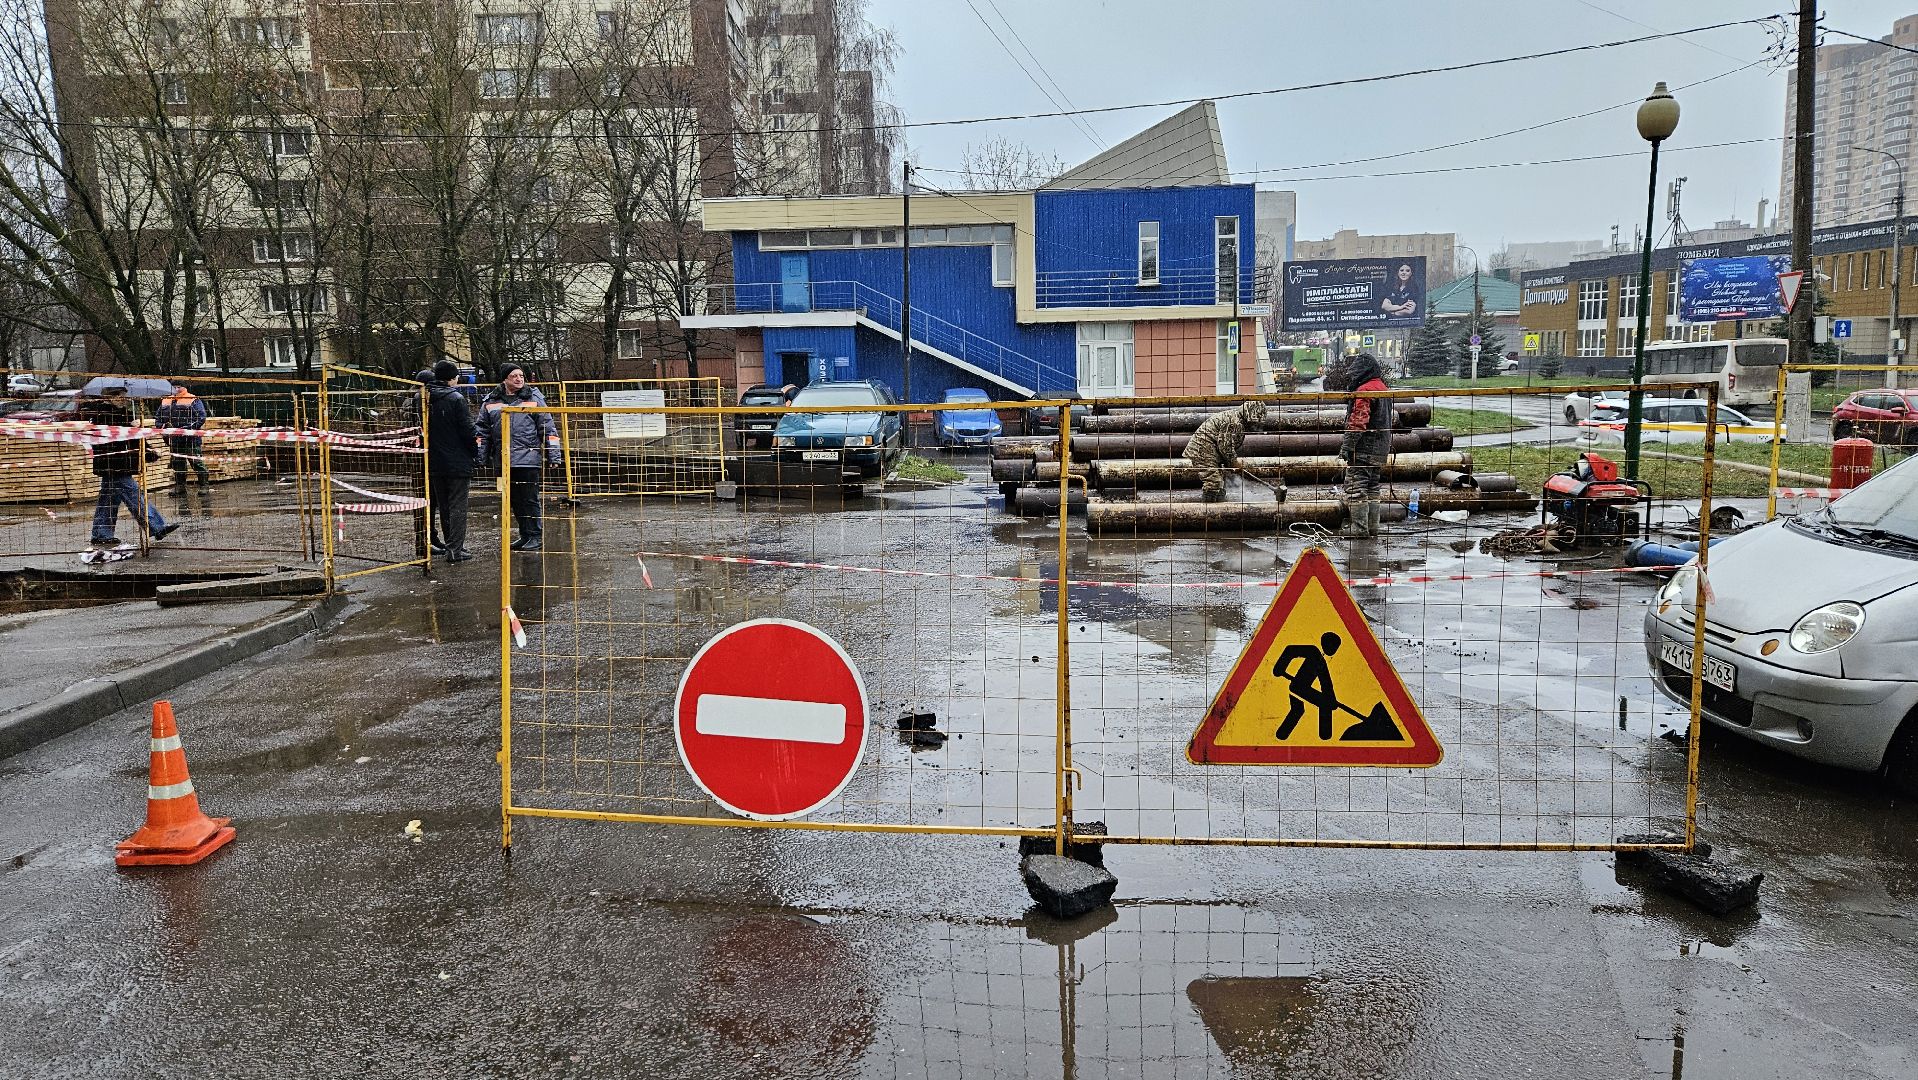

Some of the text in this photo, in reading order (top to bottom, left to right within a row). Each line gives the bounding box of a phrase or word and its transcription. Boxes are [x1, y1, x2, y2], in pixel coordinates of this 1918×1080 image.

[1676, 248, 1720, 259] ЛОМБАРД
[1524, 276, 1543, 288] ТОРГОВЫЙ
[1704, 280, 1722, 289] Мы
[1306, 285, 1369, 296] ИМПЛАНТАТЫ
[1711, 288, 1737, 296] Новый
[1523, 288, 1569, 306] Долгопрудн
